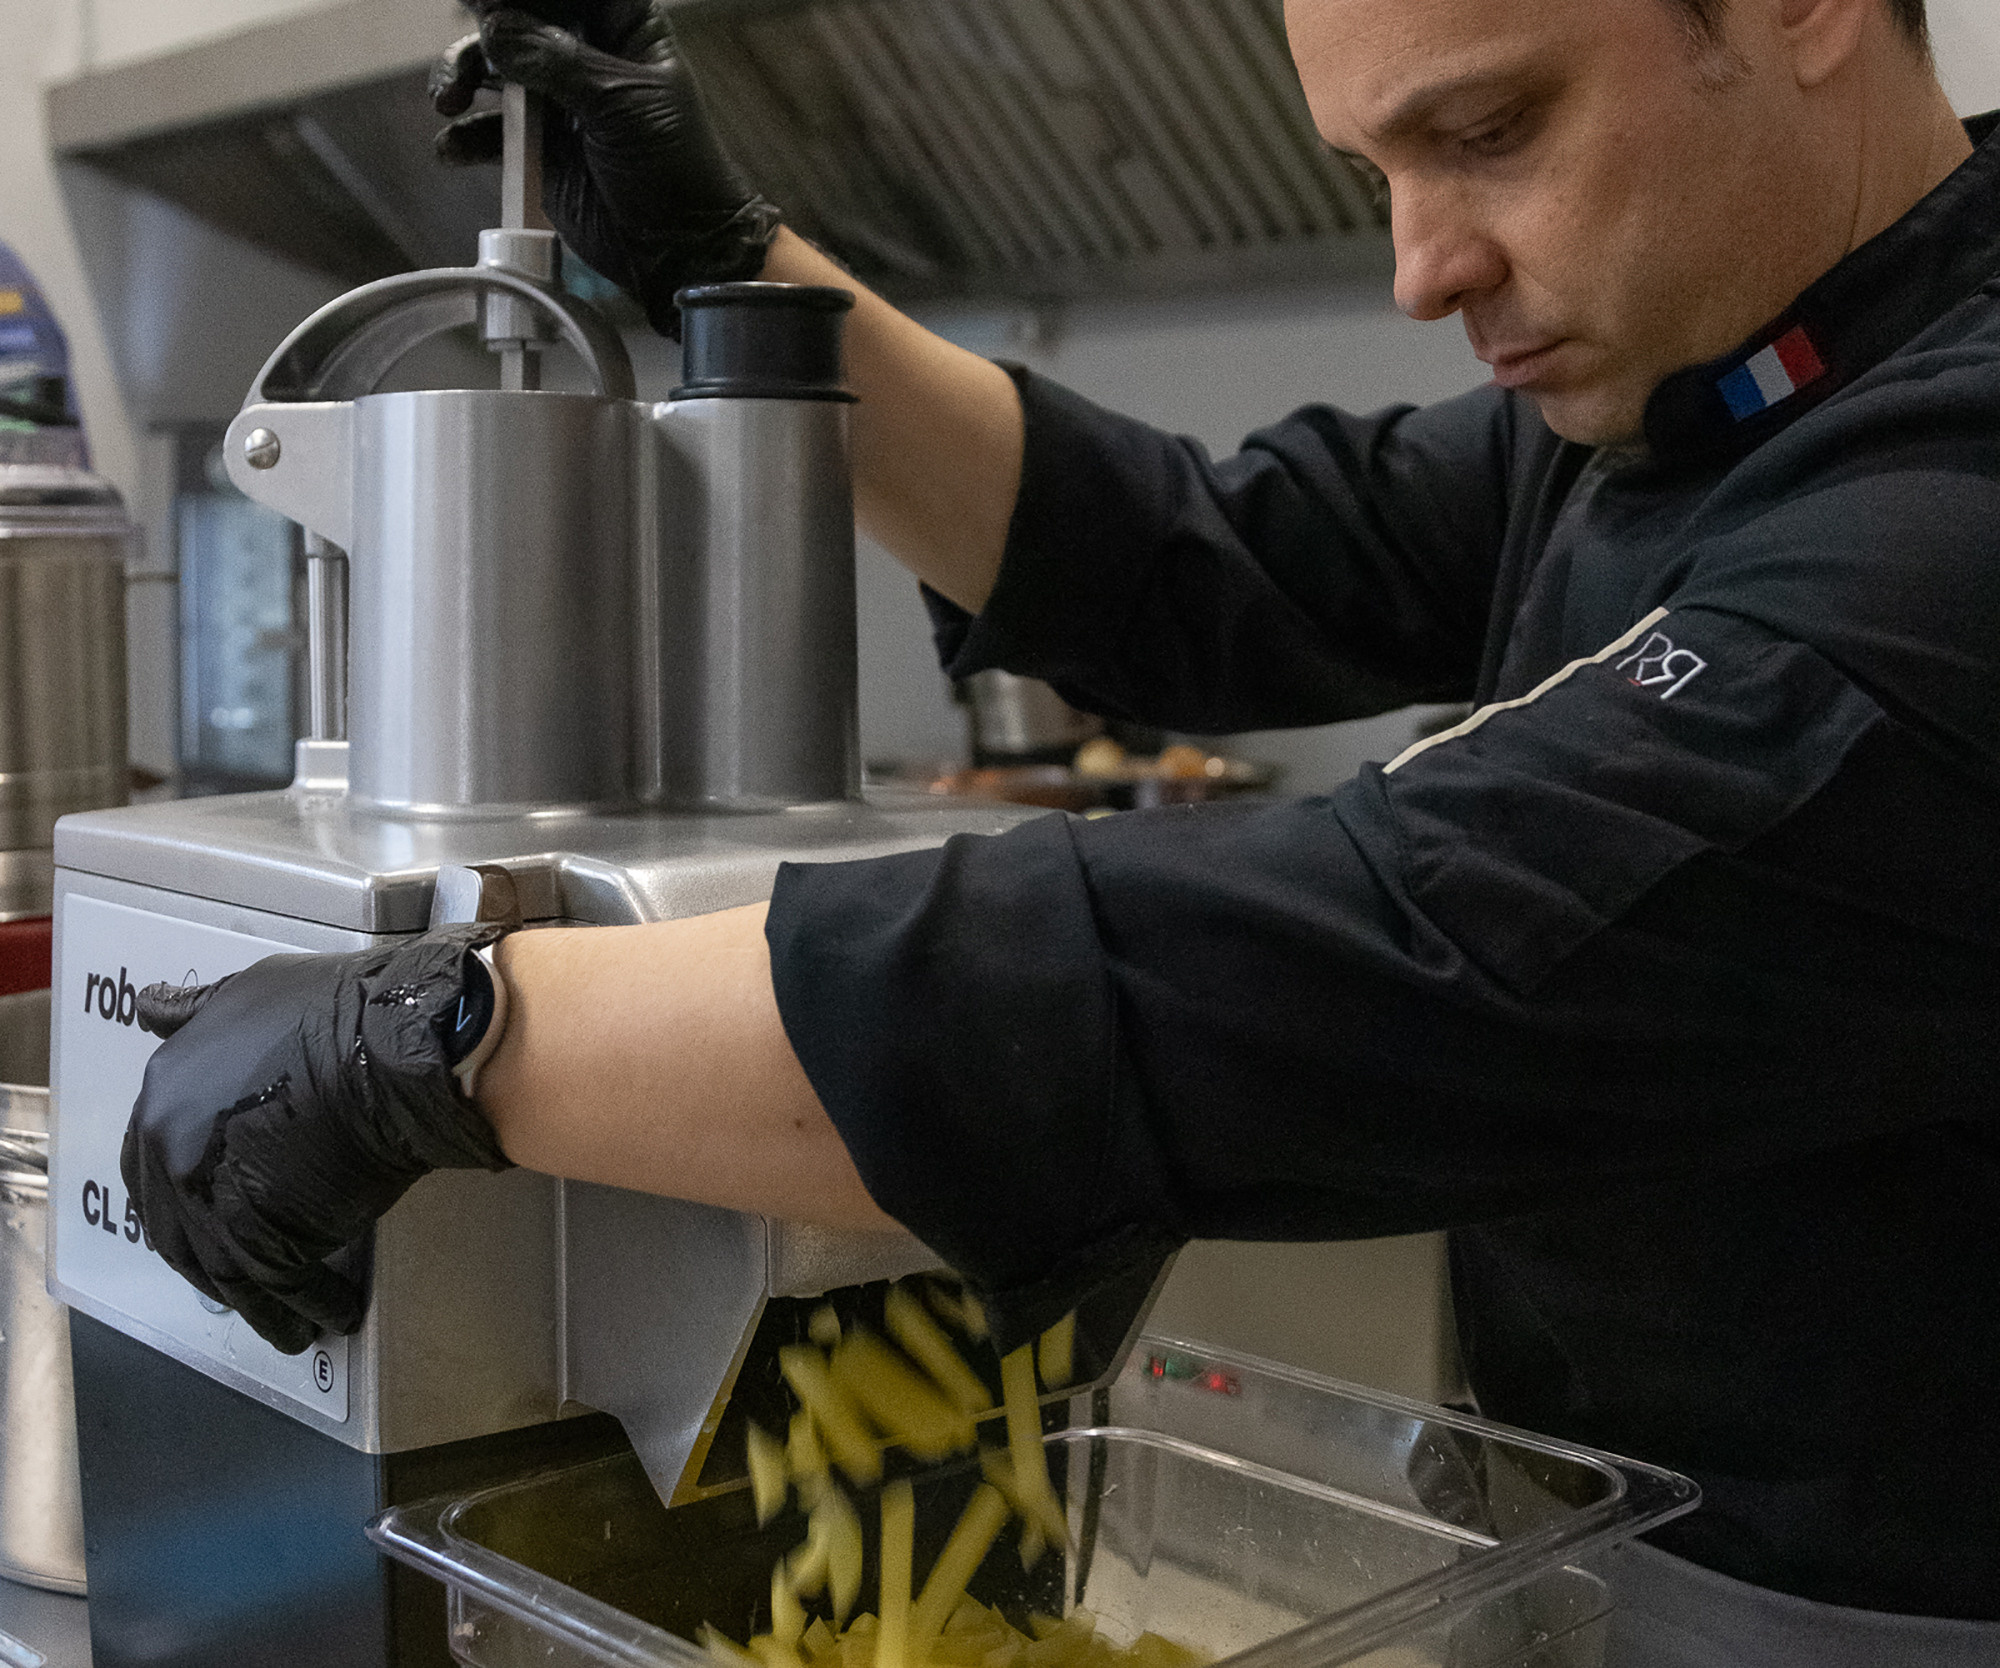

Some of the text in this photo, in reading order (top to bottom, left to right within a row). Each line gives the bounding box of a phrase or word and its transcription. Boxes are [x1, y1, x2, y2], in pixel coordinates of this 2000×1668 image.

[84, 966, 151, 1032] rob
[82, 1179, 156, 1252] CL 5
